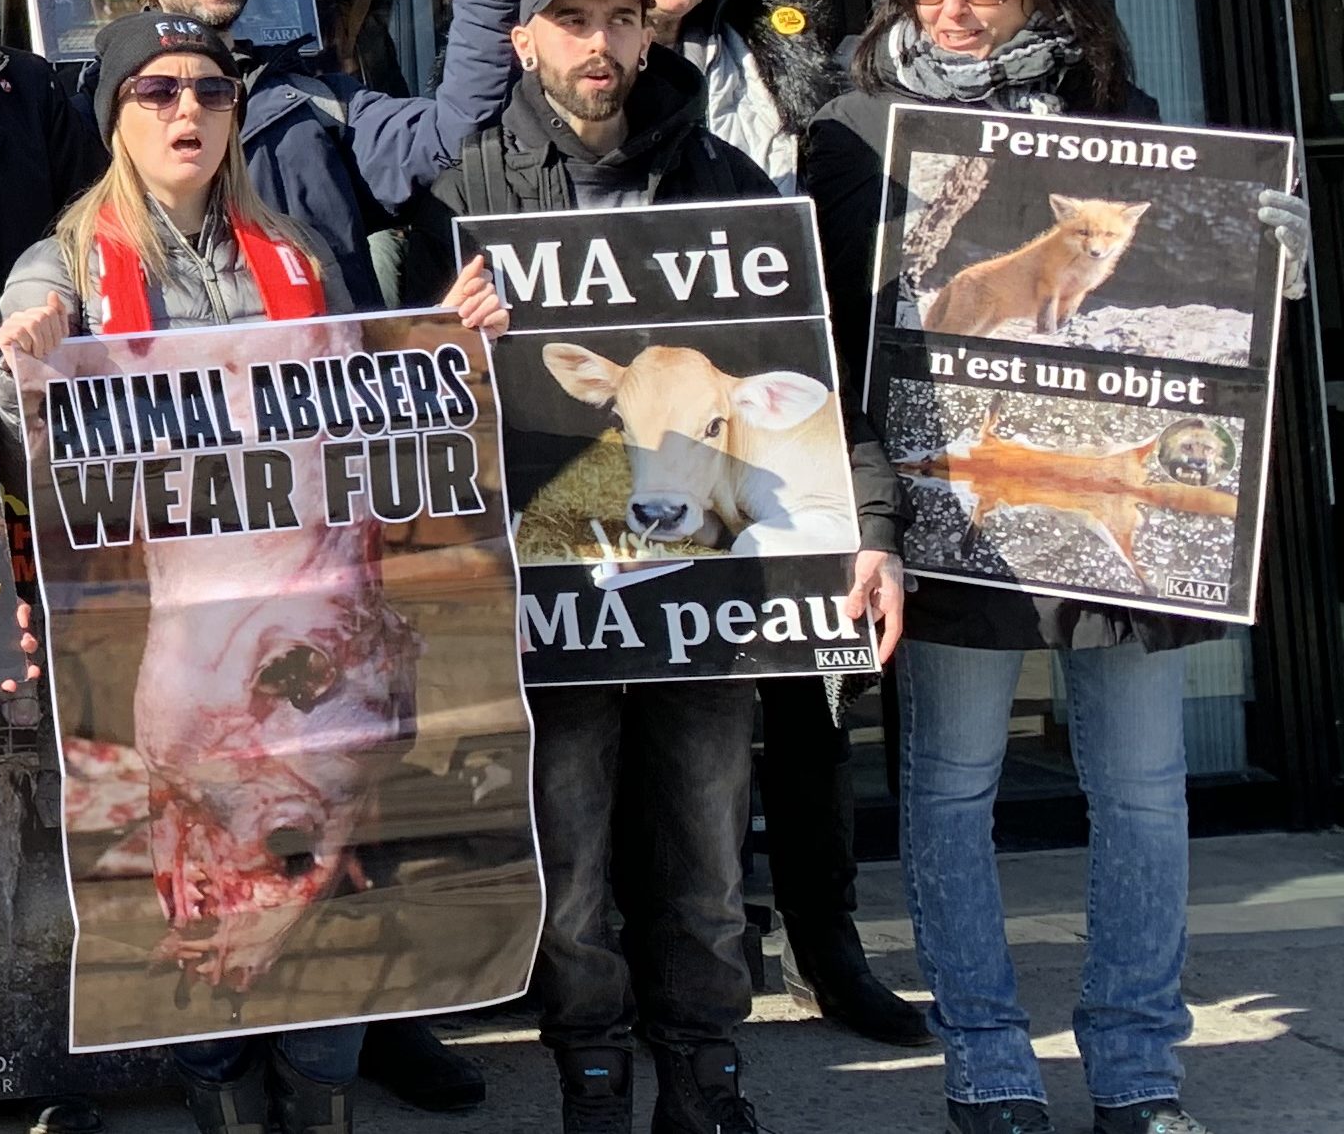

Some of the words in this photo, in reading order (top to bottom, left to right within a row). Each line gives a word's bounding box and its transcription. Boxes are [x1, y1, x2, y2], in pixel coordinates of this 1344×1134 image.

[979, 122, 1198, 171] Personne
[486, 238, 636, 308] MA
[653, 231, 789, 300] vie
[46, 366, 244, 462] ANIMAL
[248, 343, 478, 443] ABUSERS
[930, 346, 1026, 386] n'est
[1036, 364, 1086, 392] un
[1098, 367, 1205, 408] objet
[51, 445, 300, 550] WEAR
[322, 430, 487, 528] FUR
[1168, 579, 1225, 602] KARA
[520, 591, 644, 652] MA
[661, 594, 860, 664] peau
[817, 650, 870, 667] KARA
